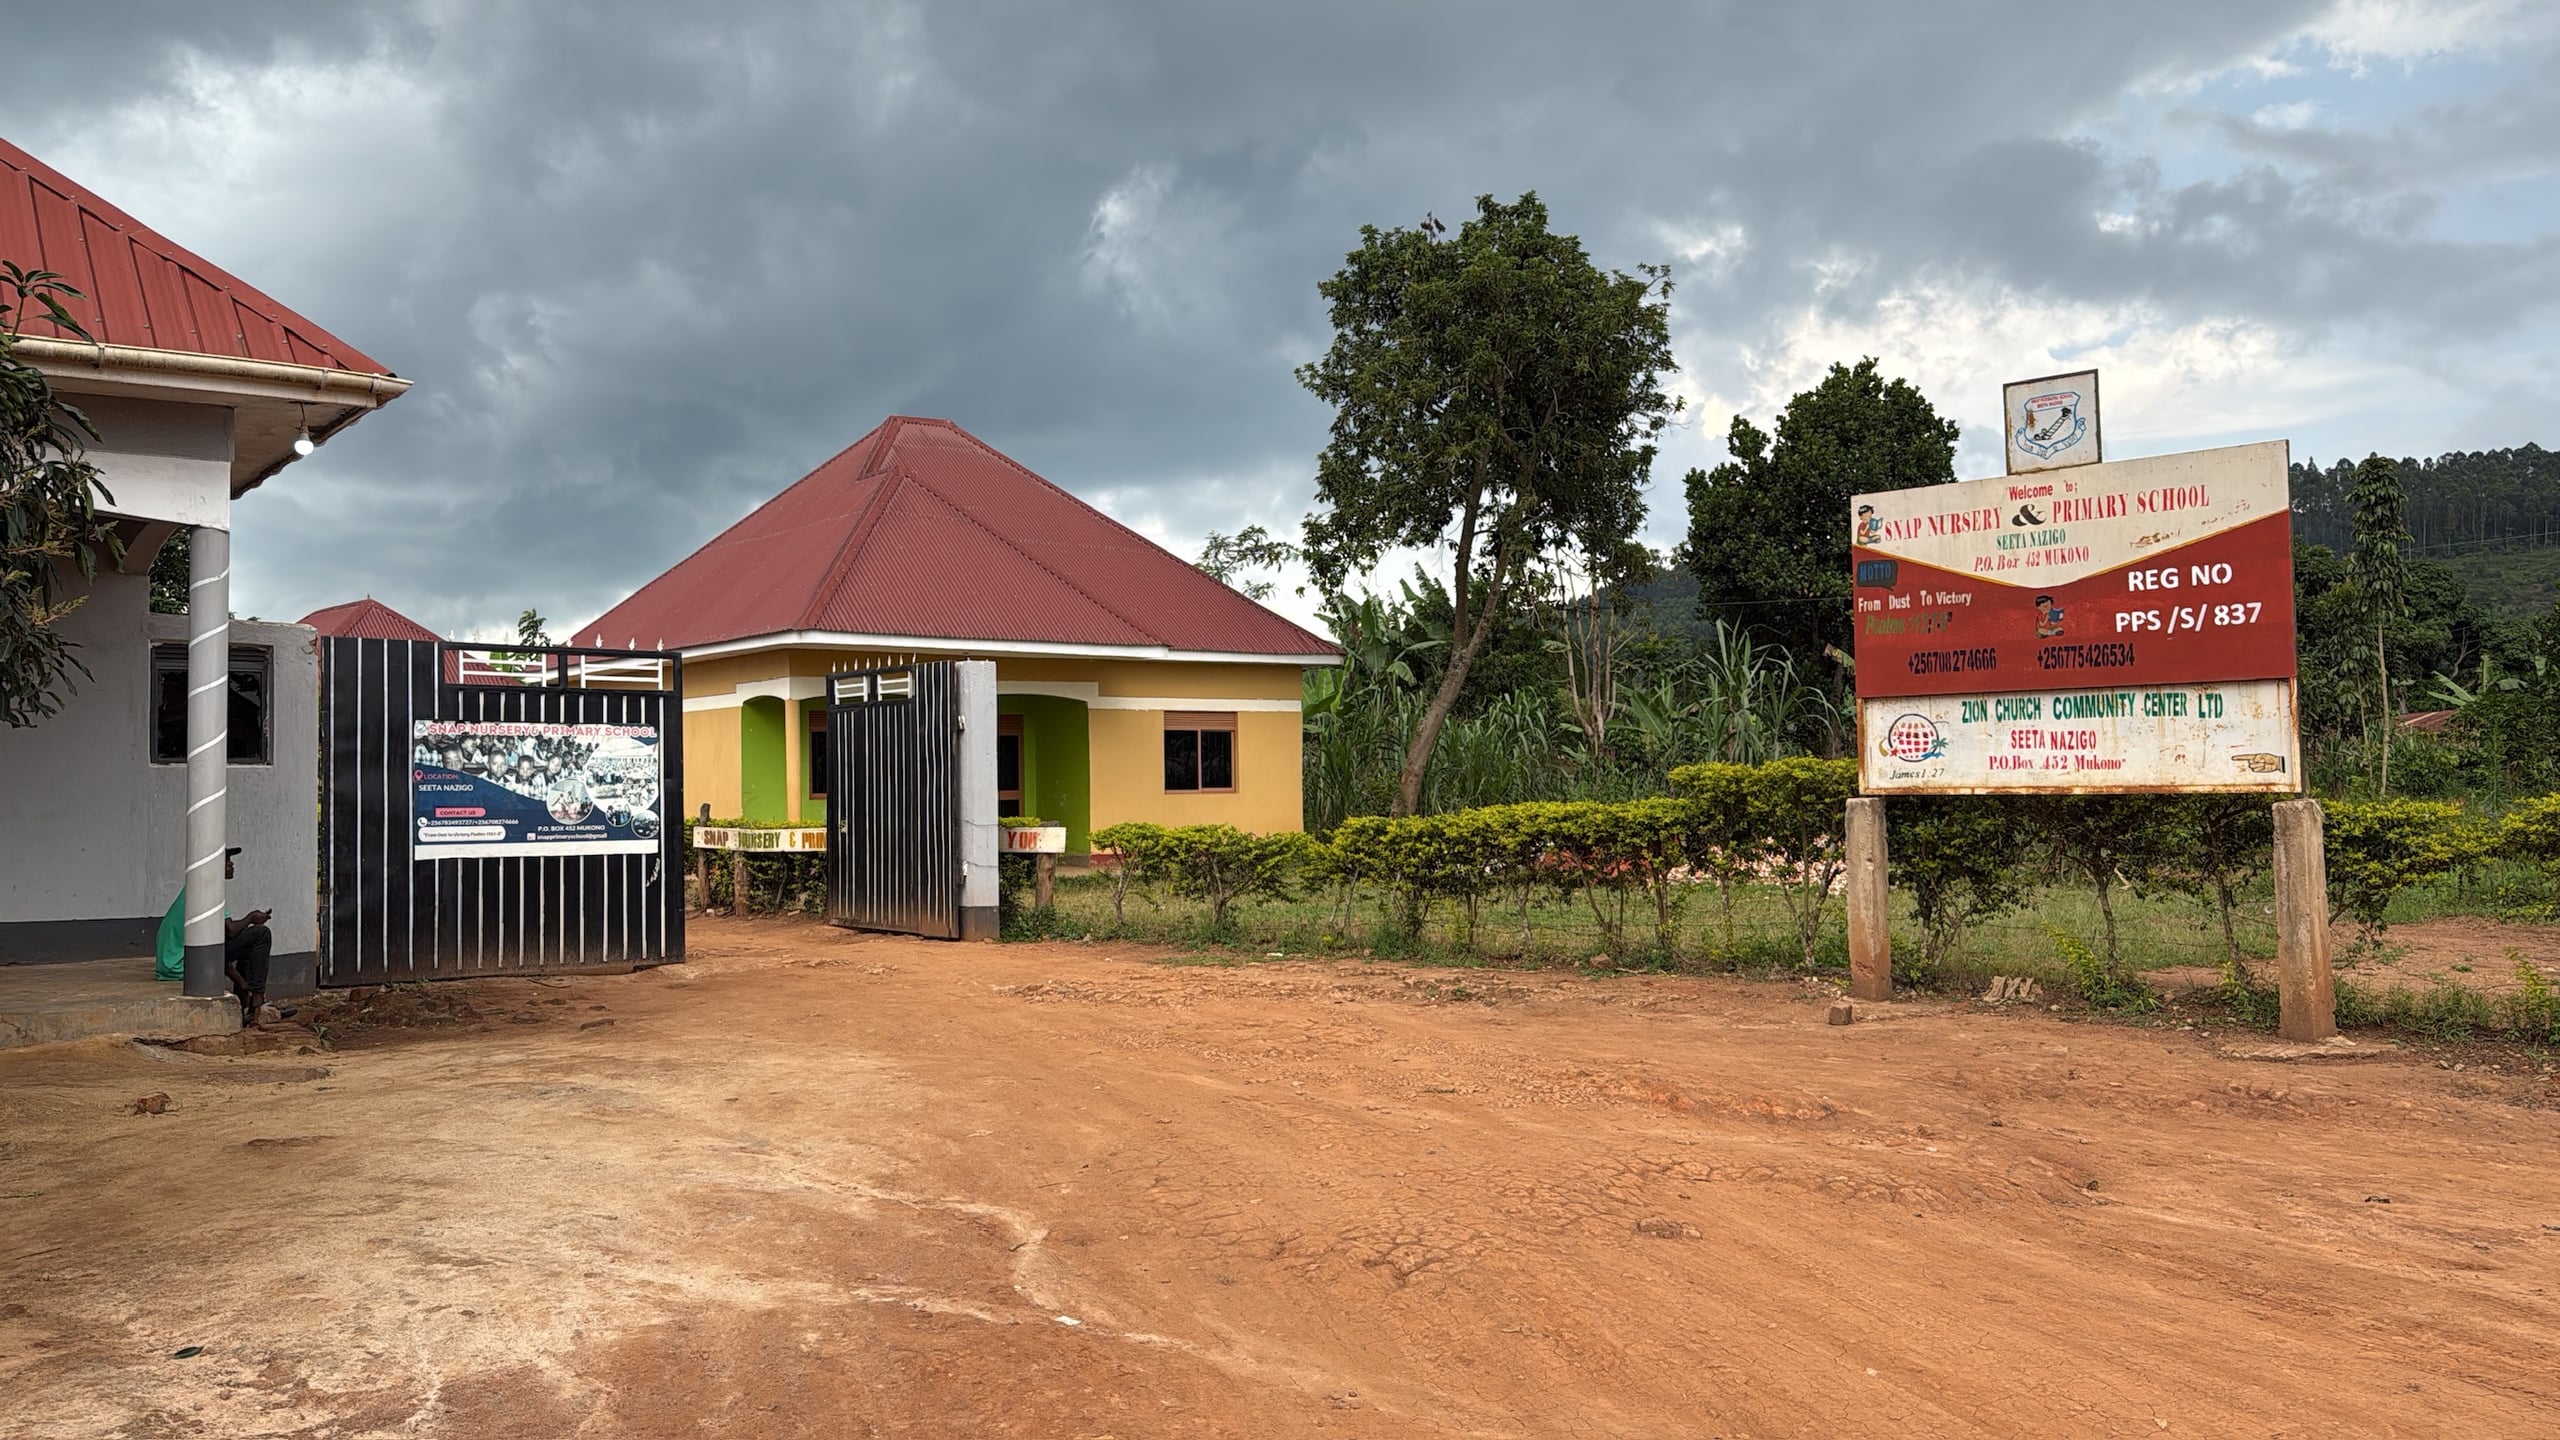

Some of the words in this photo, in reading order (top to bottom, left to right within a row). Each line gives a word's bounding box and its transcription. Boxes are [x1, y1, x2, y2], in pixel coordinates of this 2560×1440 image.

[2008, 484, 2053, 501] Welcome
[1885, 517, 1922, 541] SNAP
[1927, 507, 2002, 537] NURSERY
[2011, 504, 2047, 527] &
[2052, 493, 2129, 524] PRIMARY
[2137, 484, 2210, 514] SCHOOL
[1996, 532, 2026, 550] SEETA
[2029, 528, 2066, 548] NAZIGO
[1974, 556, 1994, 573] P.O.
[1997, 554, 2019, 571] Box
[2044, 546, 2089, 566] MUKONO
[1860, 562, 1892, 581] MOTTO
[2128, 567, 2179, 592] REG
[2191, 563, 2233, 587] NO
[1858, 597, 1881, 612] From
[1888, 593, 1911, 610] Dust
[1920, 590, 1933, 606] To
[1935, 590, 1972, 606] Victory
[1961, 700, 1988, 724] ZION
[1995, 697, 2041, 722] CHURCH
[2053, 692, 2136, 720] COMMUNITY
[2144, 692, 2188, 717] CENTER
[2198, 693, 2223, 718] LTD
[429, 724, 466, 735] SNAP
[543, 726, 601, 737] PRIMARY
[605, 726, 657, 738] SCHOOL
[2010, 729, 2046, 750] SEETA
[2050, 730, 2097, 751] NAZIGO
[418, 784, 441, 792] SEETA
[443, 784, 474, 792] NAZIGO
[704, 830, 728, 847] SNAP
[738, 831, 780, 849] NURSERY
[1008, 831, 1038, 849] YOU
